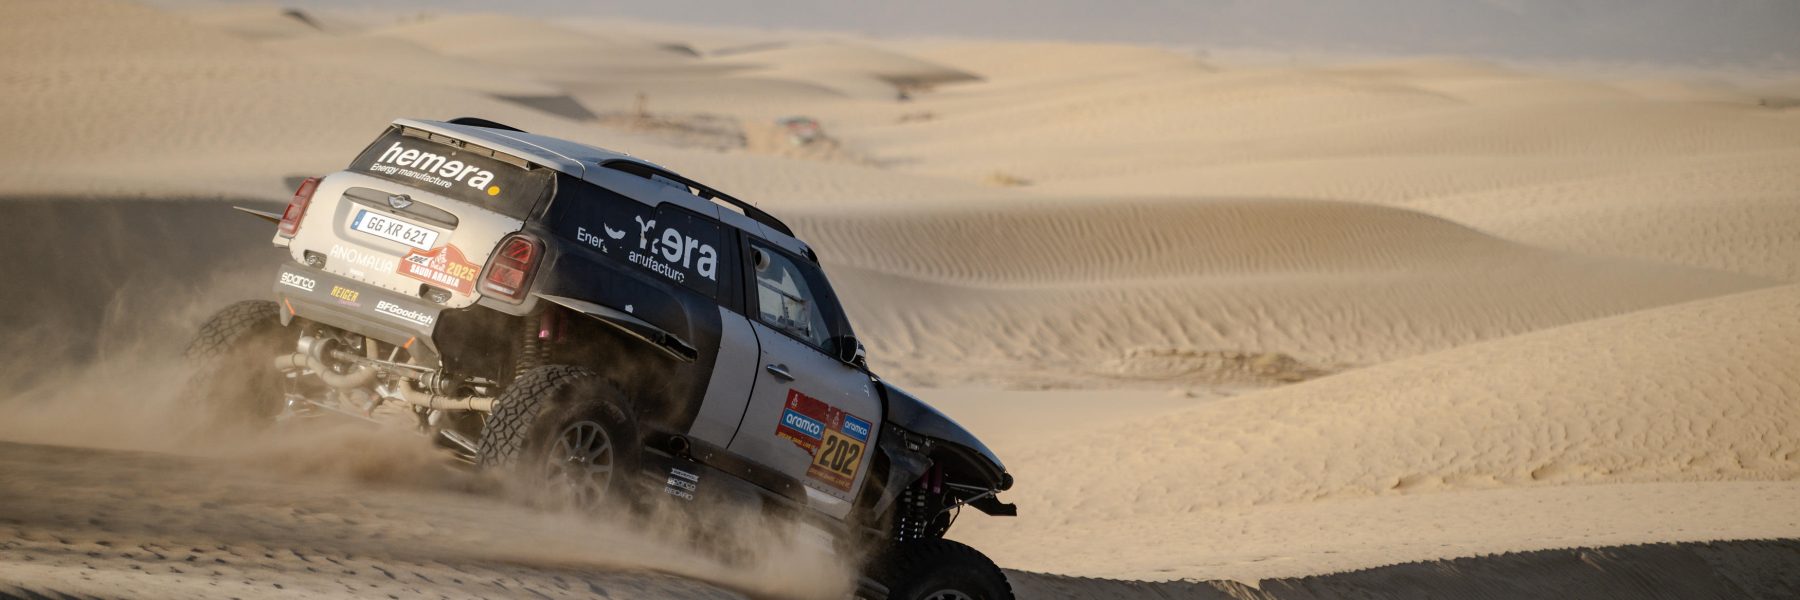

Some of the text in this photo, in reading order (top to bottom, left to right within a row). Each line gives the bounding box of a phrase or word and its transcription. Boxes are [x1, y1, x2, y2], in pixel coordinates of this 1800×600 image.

[370, 163, 452, 189] Energy manufacture
[367, 217, 428, 245] GG XR 621
[329, 244, 394, 274] ANOMALIA
[447, 262, 476, 281] 2025
[280, 272, 316, 290] sparco
[410, 263, 460, 288] SAUDI ARABIA
[331, 285, 360, 301] REIGER
[376, 300, 433, 325] BFGoodrich
[786, 413, 820, 435] aramco
[844, 420, 867, 436] aramco
[820, 435, 860, 475] 202
